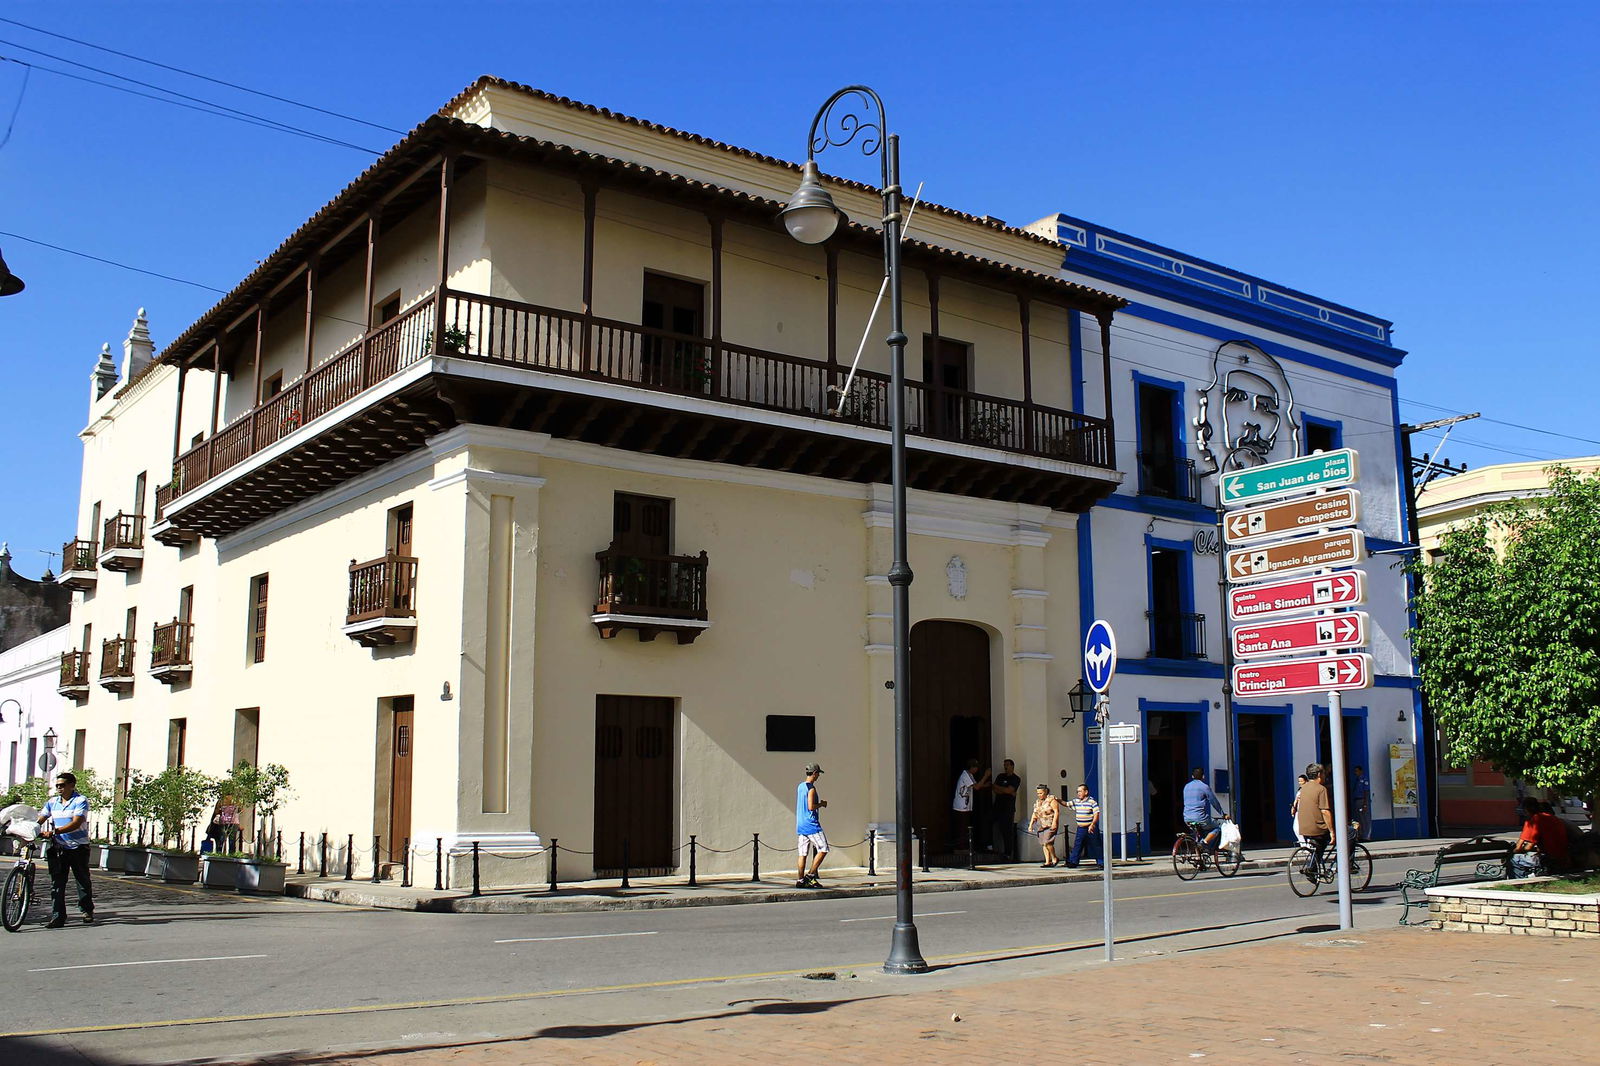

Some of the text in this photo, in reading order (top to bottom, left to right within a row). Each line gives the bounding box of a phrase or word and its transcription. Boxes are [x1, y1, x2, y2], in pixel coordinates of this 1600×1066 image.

[1325, 458, 1345, 468] plaza
[1257, 467, 1347, 491] San Juan de Dios
[1315, 498, 1348, 511] Casino
[1298, 509, 1349, 524] Campestre
[1324, 538, 1350, 549] parque
[1269, 549, 1351, 571] Ignacio Agramonte
[1235, 593, 1256, 602] quinta
[1236, 595, 1311, 614] Amalia Simoni
[1238, 639, 1292, 652] Santa Ana
[1239, 671, 1260, 679] teatro
[1240, 678, 1286, 690] Principal
